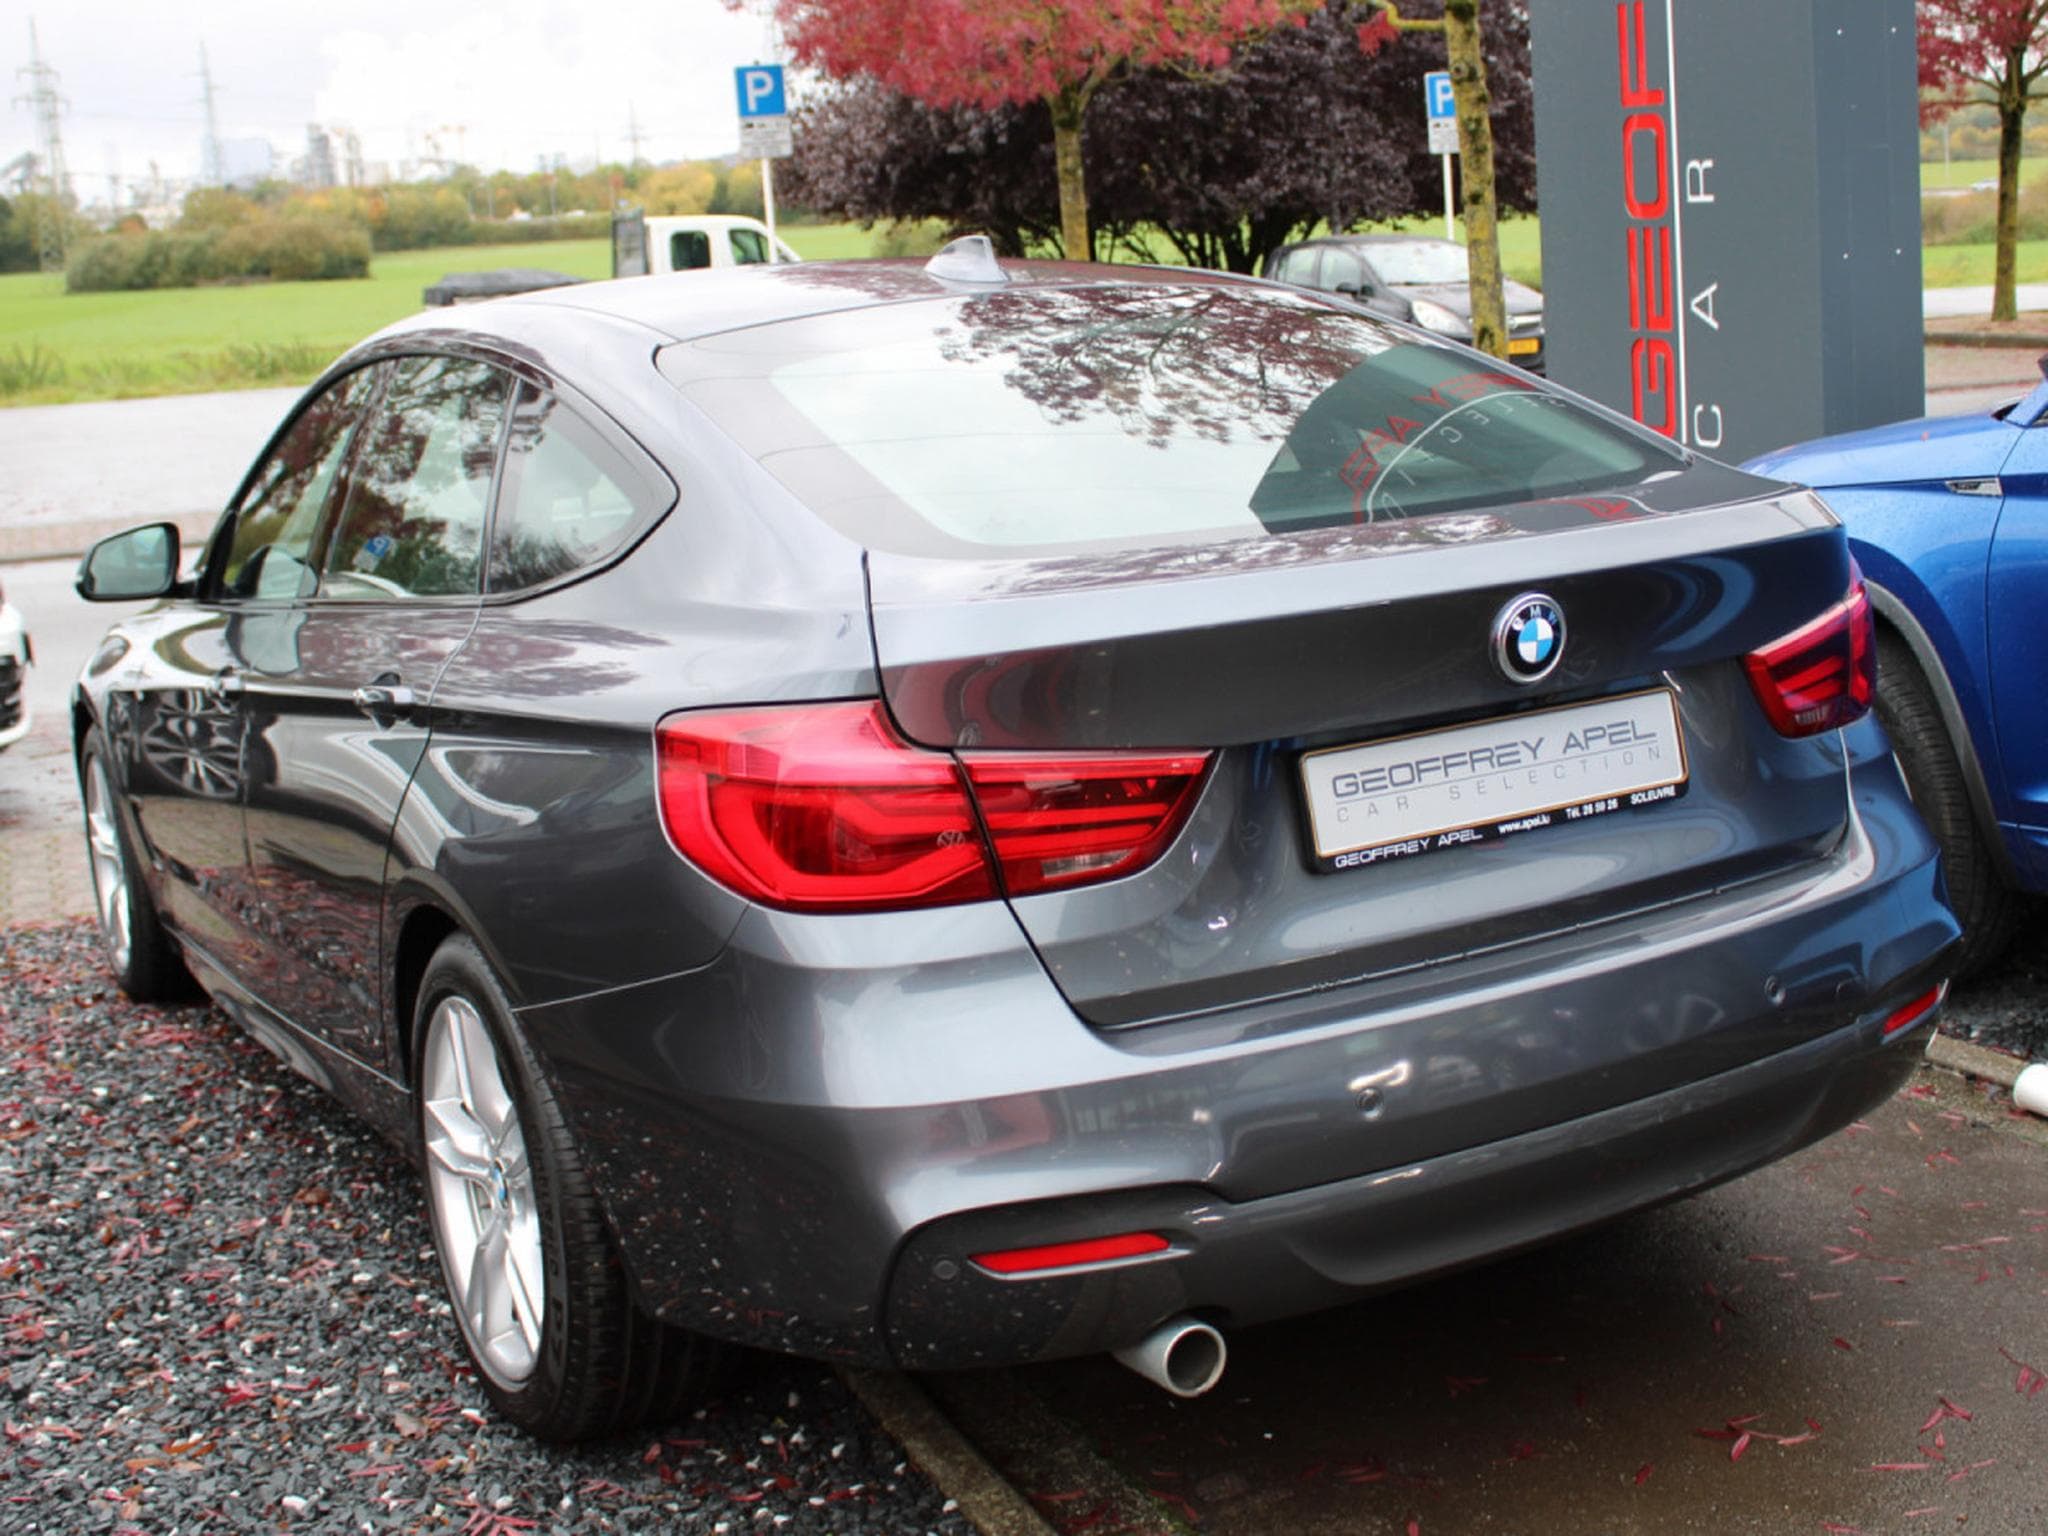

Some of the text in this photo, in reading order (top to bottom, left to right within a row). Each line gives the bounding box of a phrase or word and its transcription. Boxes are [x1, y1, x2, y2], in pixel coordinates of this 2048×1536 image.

[745, 71, 775, 112] P
[1436, 79, 1454, 113] P
[1686, 158, 1723, 449] CAR
[1332, 719, 1657, 798] GEOFFREY APEL
[1336, 746, 1661, 822] CAR SELECTION
[1335, 838, 1429, 868] GEOFFREY
[1438, 829, 1483, 847] APEL
[1630, 784, 1675, 805] SOLEUVRE
